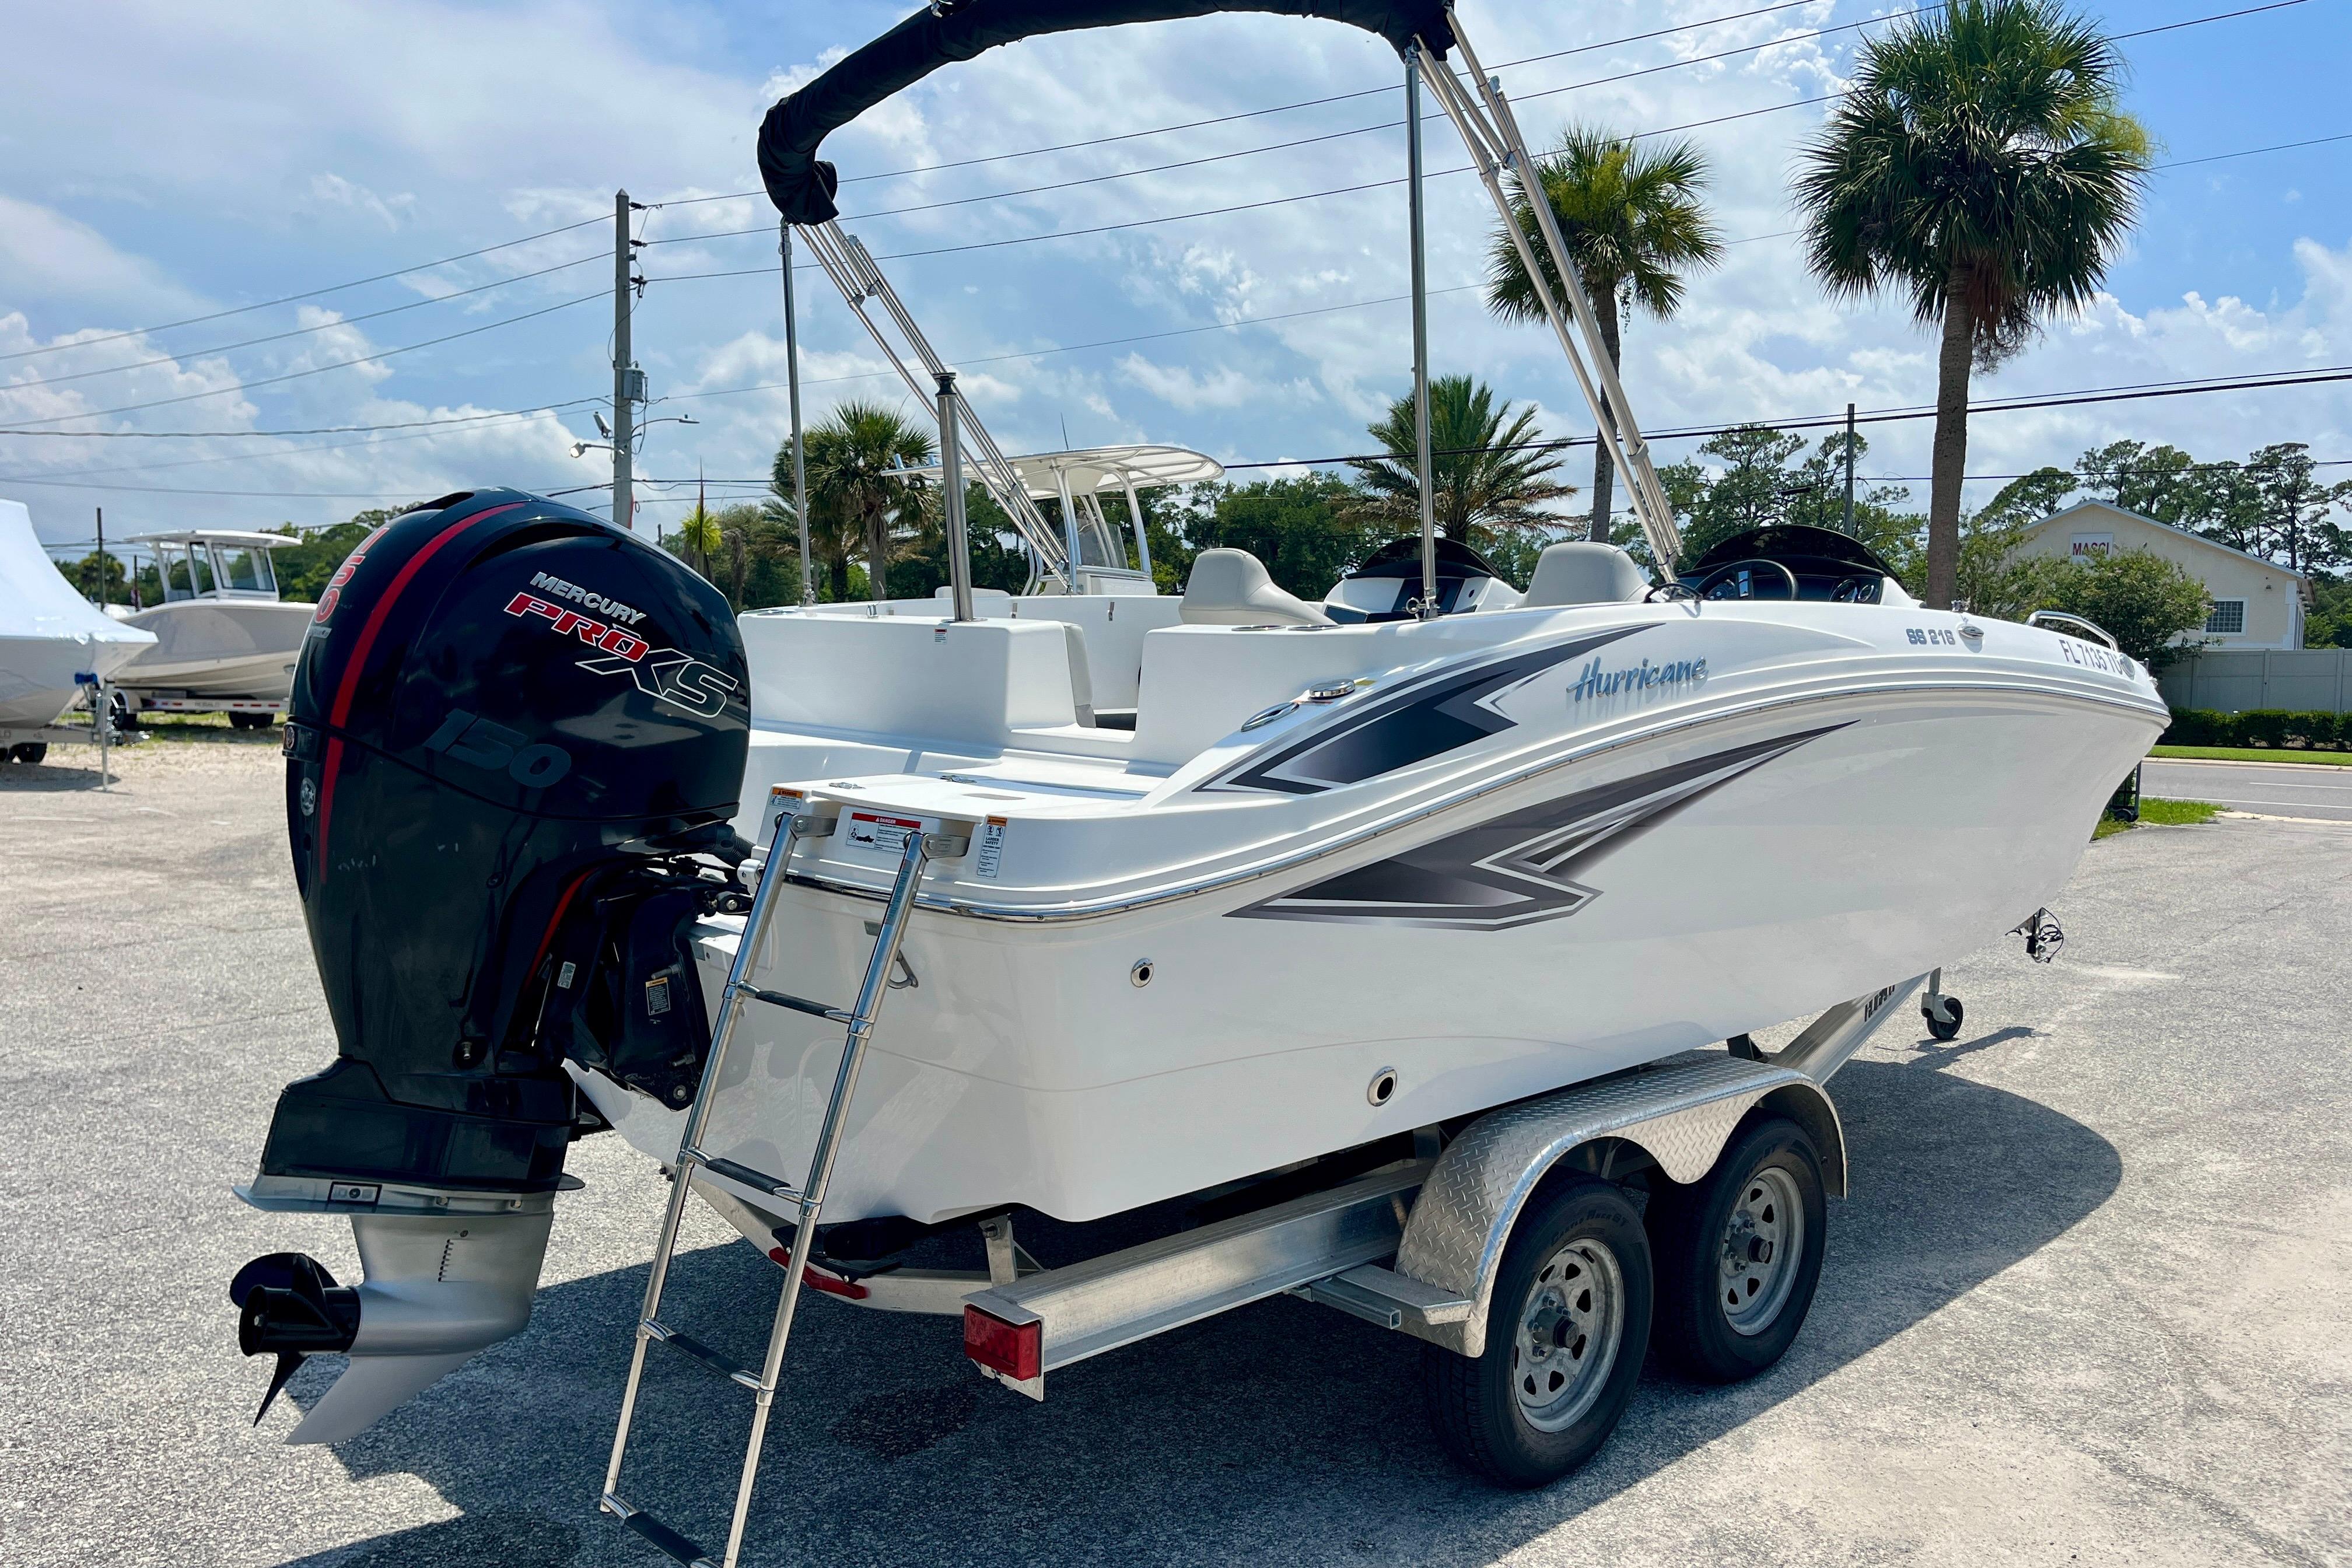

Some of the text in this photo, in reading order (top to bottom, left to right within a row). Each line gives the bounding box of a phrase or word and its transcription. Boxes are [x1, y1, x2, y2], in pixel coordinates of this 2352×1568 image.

[314, 527, 390, 624] 150
[530, 571, 646, 625] MERCURY
[503, 591, 739, 718] PRO XS
[1566, 654, 1709, 704] Hurricane
[2058, 639, 2081, 664] FL
[2076, 643, 2108, 671] 7135
[422, 708, 572, 788] 150
